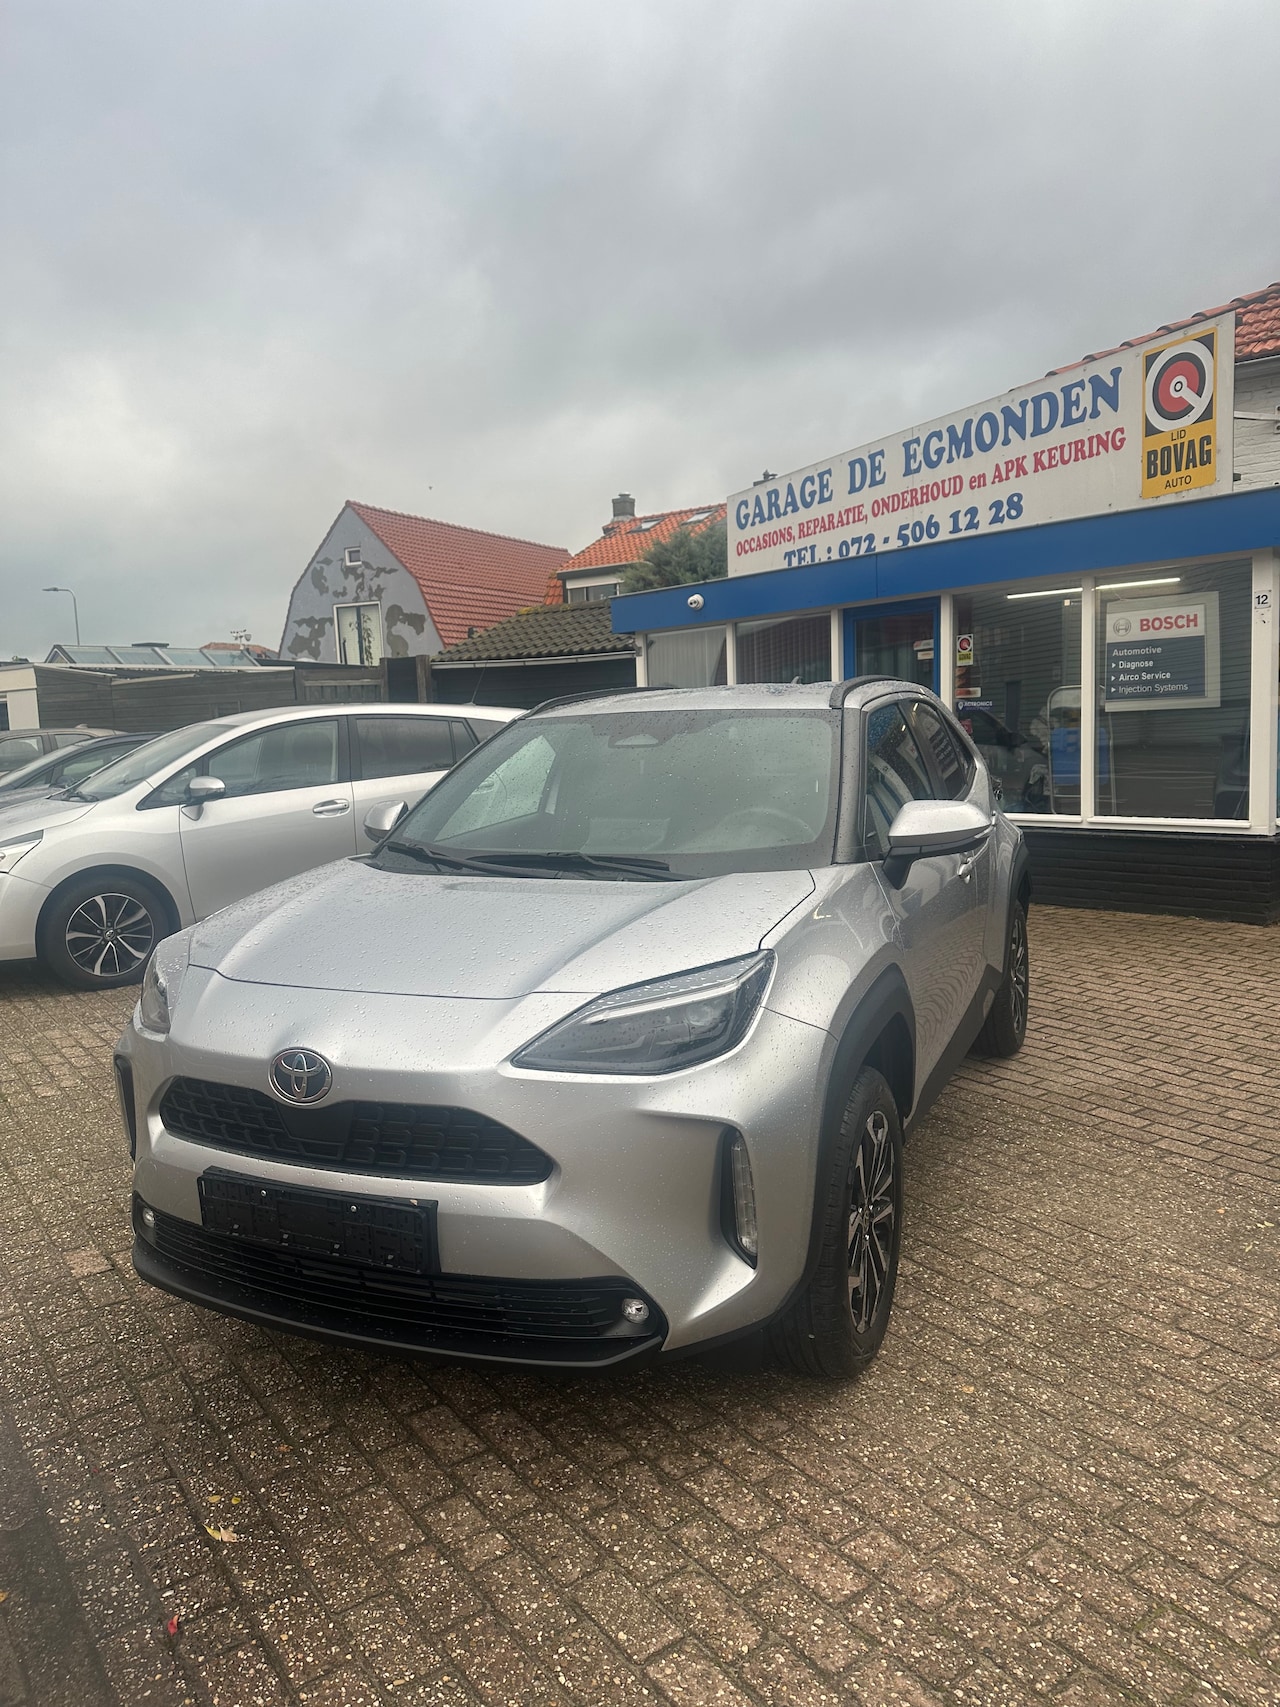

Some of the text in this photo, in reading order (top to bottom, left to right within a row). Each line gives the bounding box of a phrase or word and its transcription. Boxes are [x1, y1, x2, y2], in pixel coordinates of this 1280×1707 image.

[1171, 429, 1187, 442] LID
[736, 366, 1122, 530] GARAGE DE EGMONDEN
[1146, 434, 1212, 480] BOVAG
[1164, 475, 1192, 490] AUTO
[736, 427, 1126, 557] OCCASIONS, REPARATIE, ONDERHOUD en APK KEURING
[838, 533, 876, 558] 072
[897, 514, 940, 548] 506
[949, 506, 980, 534] 12
[988, 492, 1023, 525] 28
[1255, 594, 1269, 605] 12
[1140, 613, 1198, 632] BOSCH
[1112, 646, 1162, 656] Automotive
[1118, 660, 1154, 669] Diagnose
[1118, 671, 1171, 681] Airco Service
[1118, 683, 1189, 694] Injection Systems
